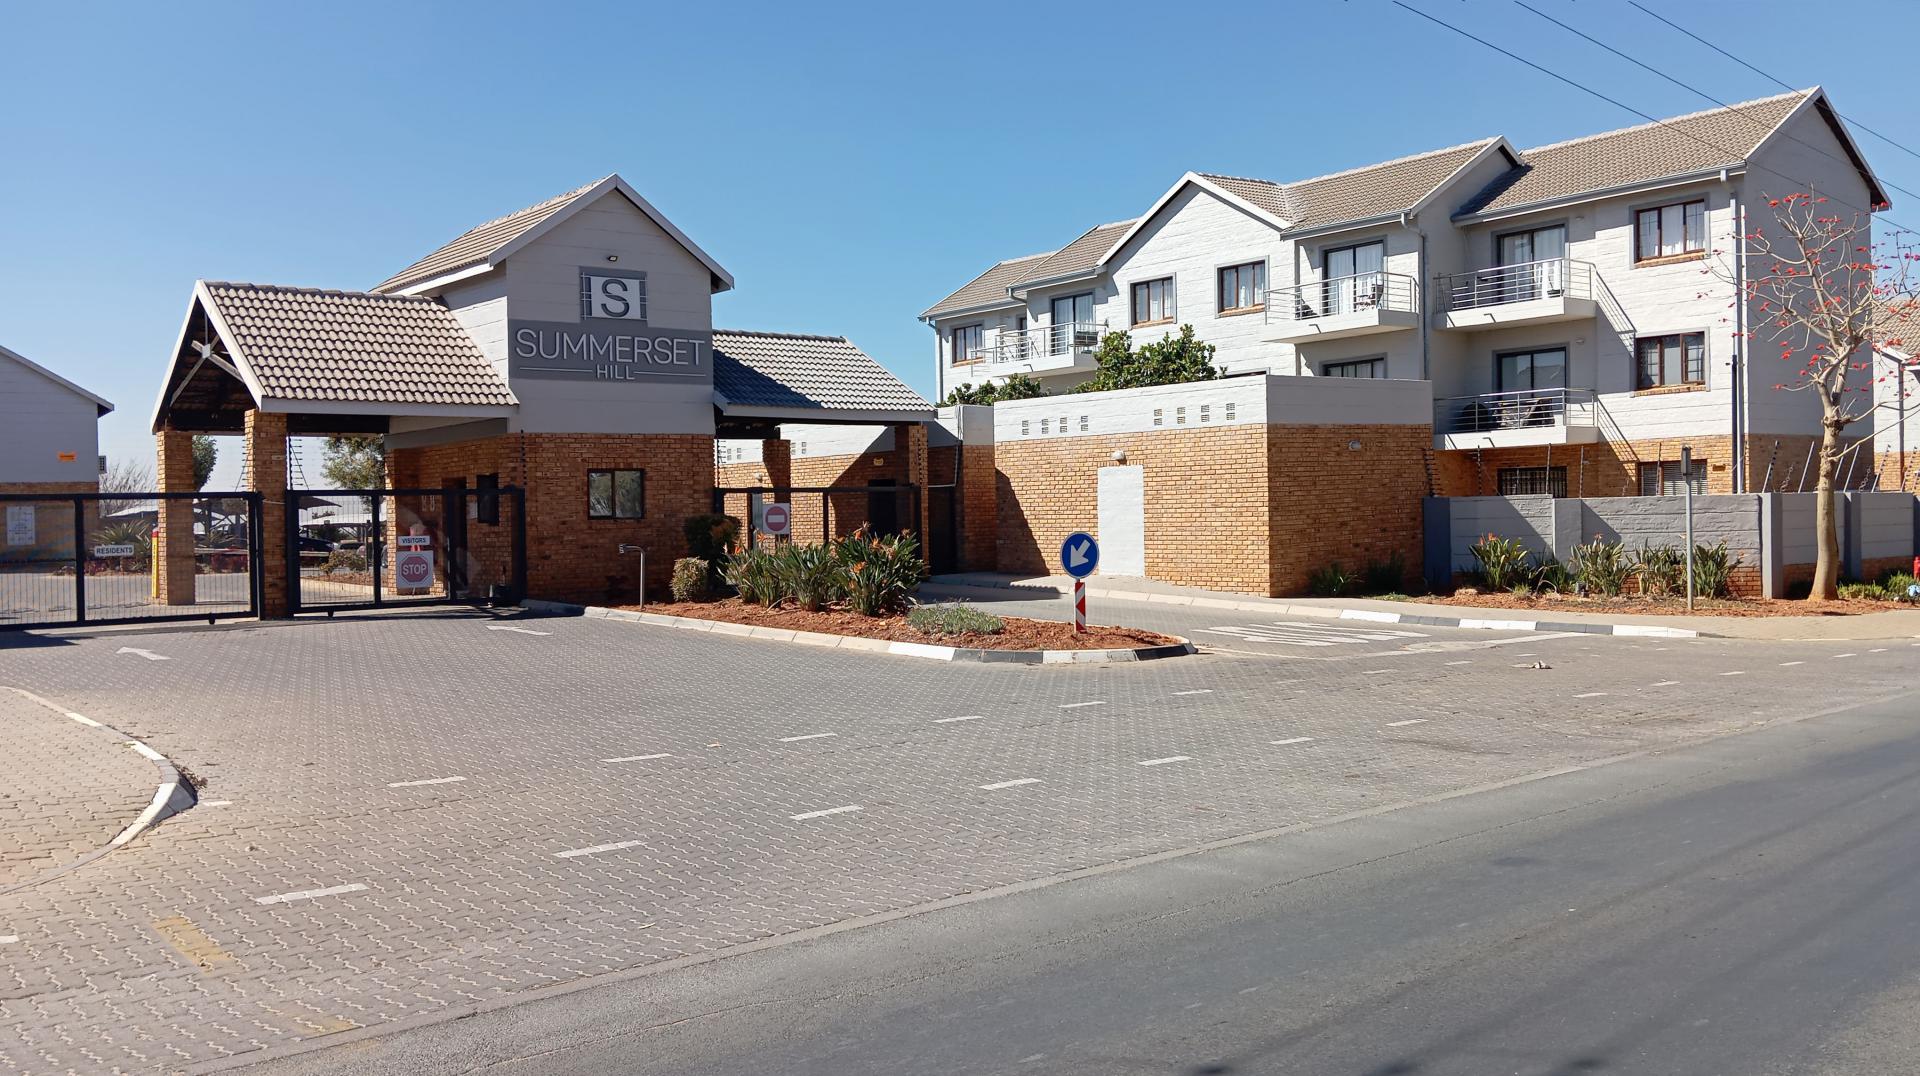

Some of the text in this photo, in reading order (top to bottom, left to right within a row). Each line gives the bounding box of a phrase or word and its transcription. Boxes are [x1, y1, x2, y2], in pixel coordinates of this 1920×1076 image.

[600, 278, 631, 318] S
[516, 329, 705, 366] SUMMERSET
[595, 364, 636, 381] HILL
[96, 547, 133, 555] RESIDENTS
[402, 563, 427, 576] STOP
